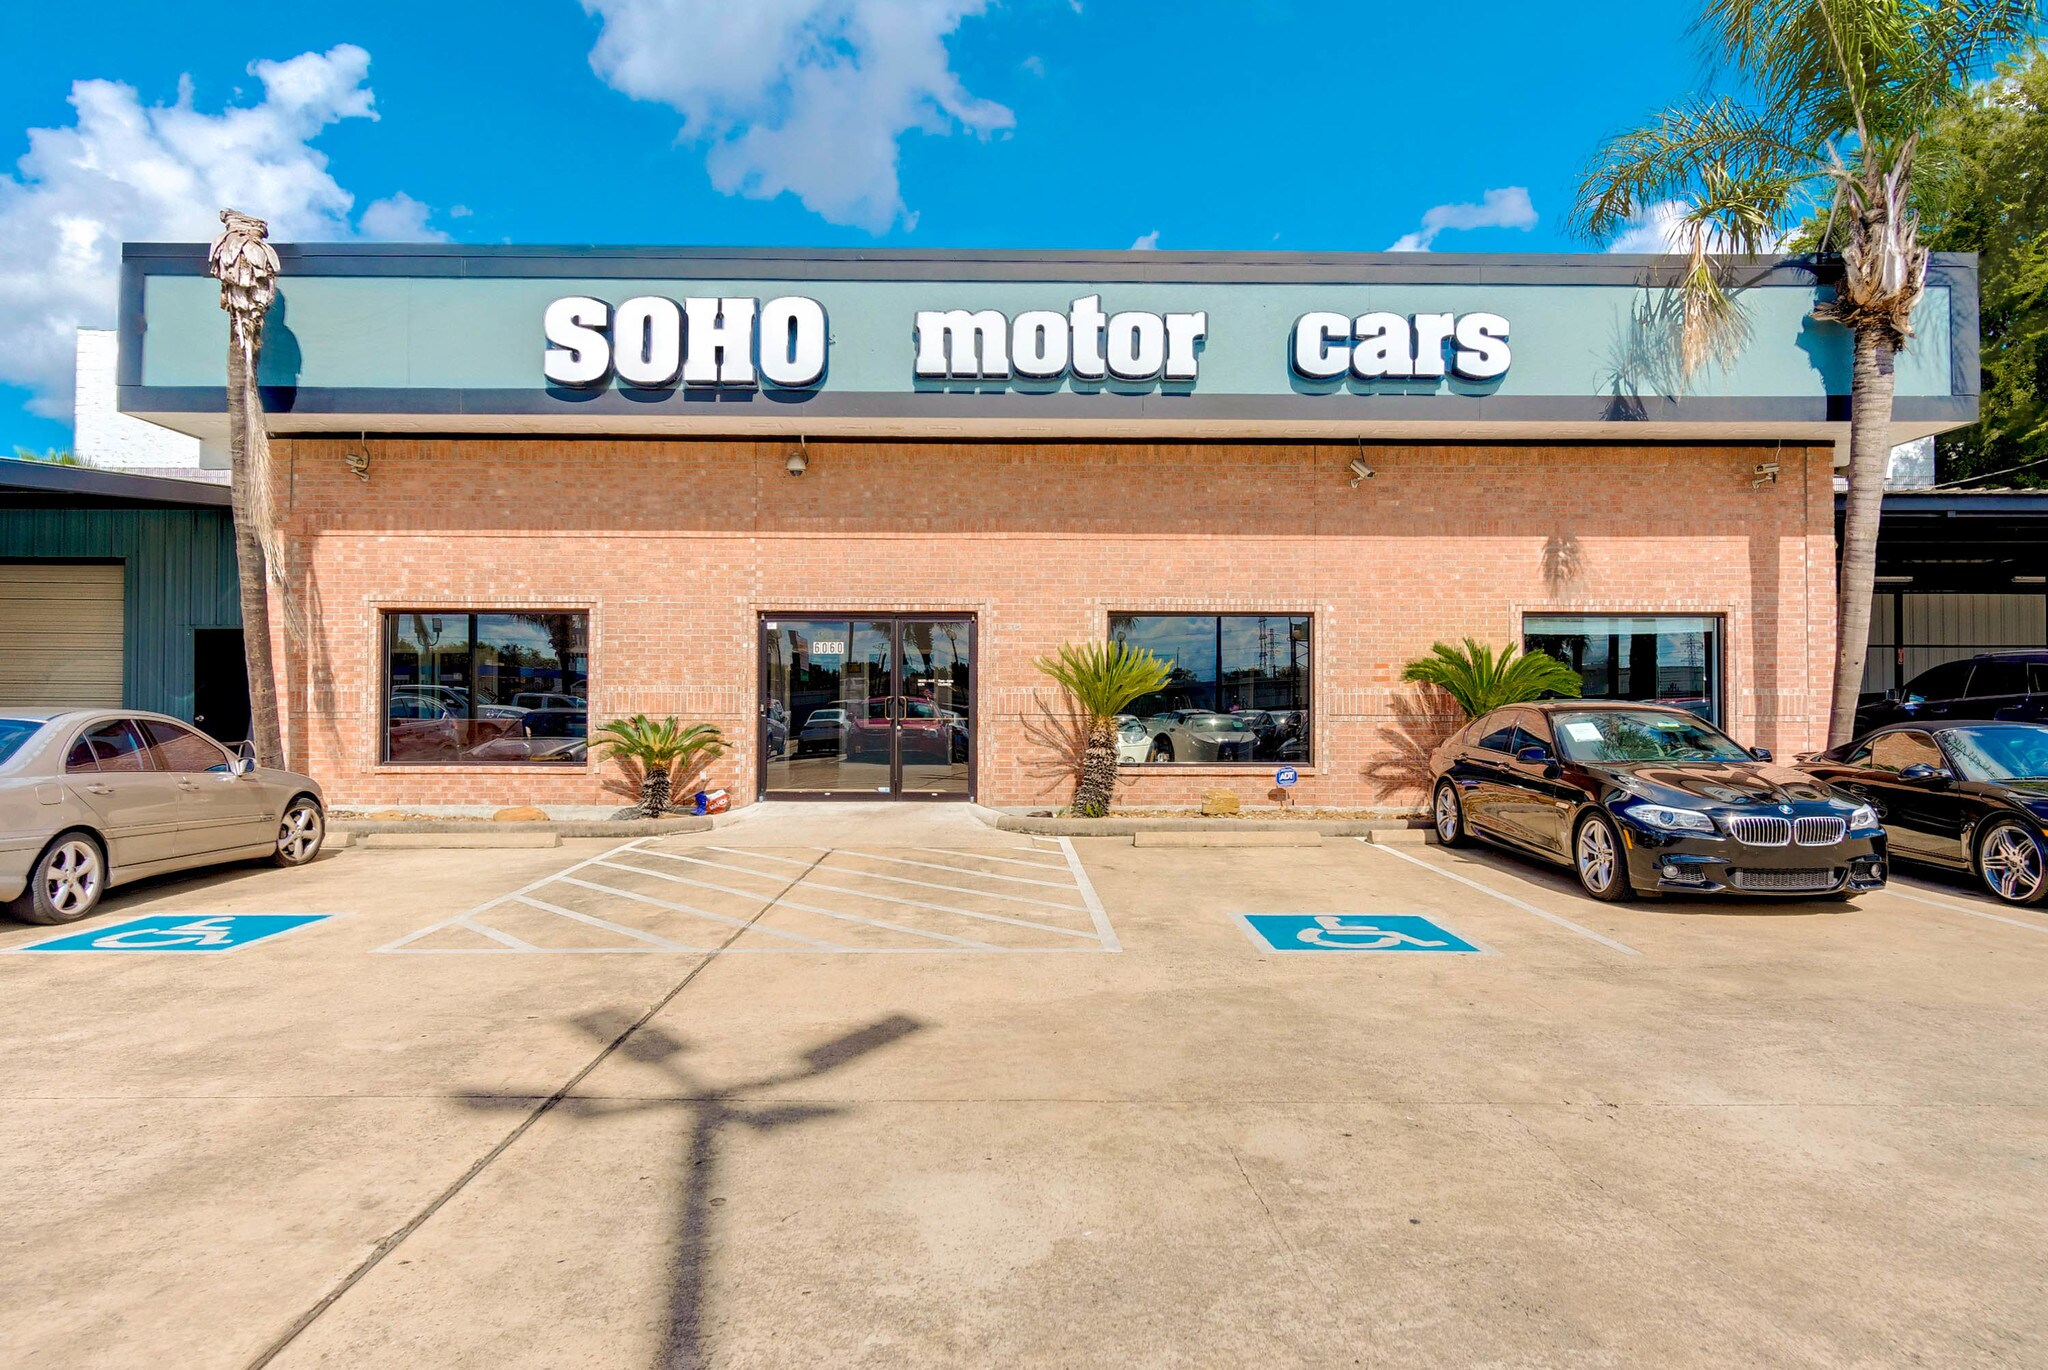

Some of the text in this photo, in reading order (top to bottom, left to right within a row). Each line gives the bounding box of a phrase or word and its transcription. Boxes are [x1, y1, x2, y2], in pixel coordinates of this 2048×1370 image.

[544, 294, 1512, 387] SOHO motor cars
[814, 642, 843, 653] 6060
[1280, 771, 1295, 780] ADT
